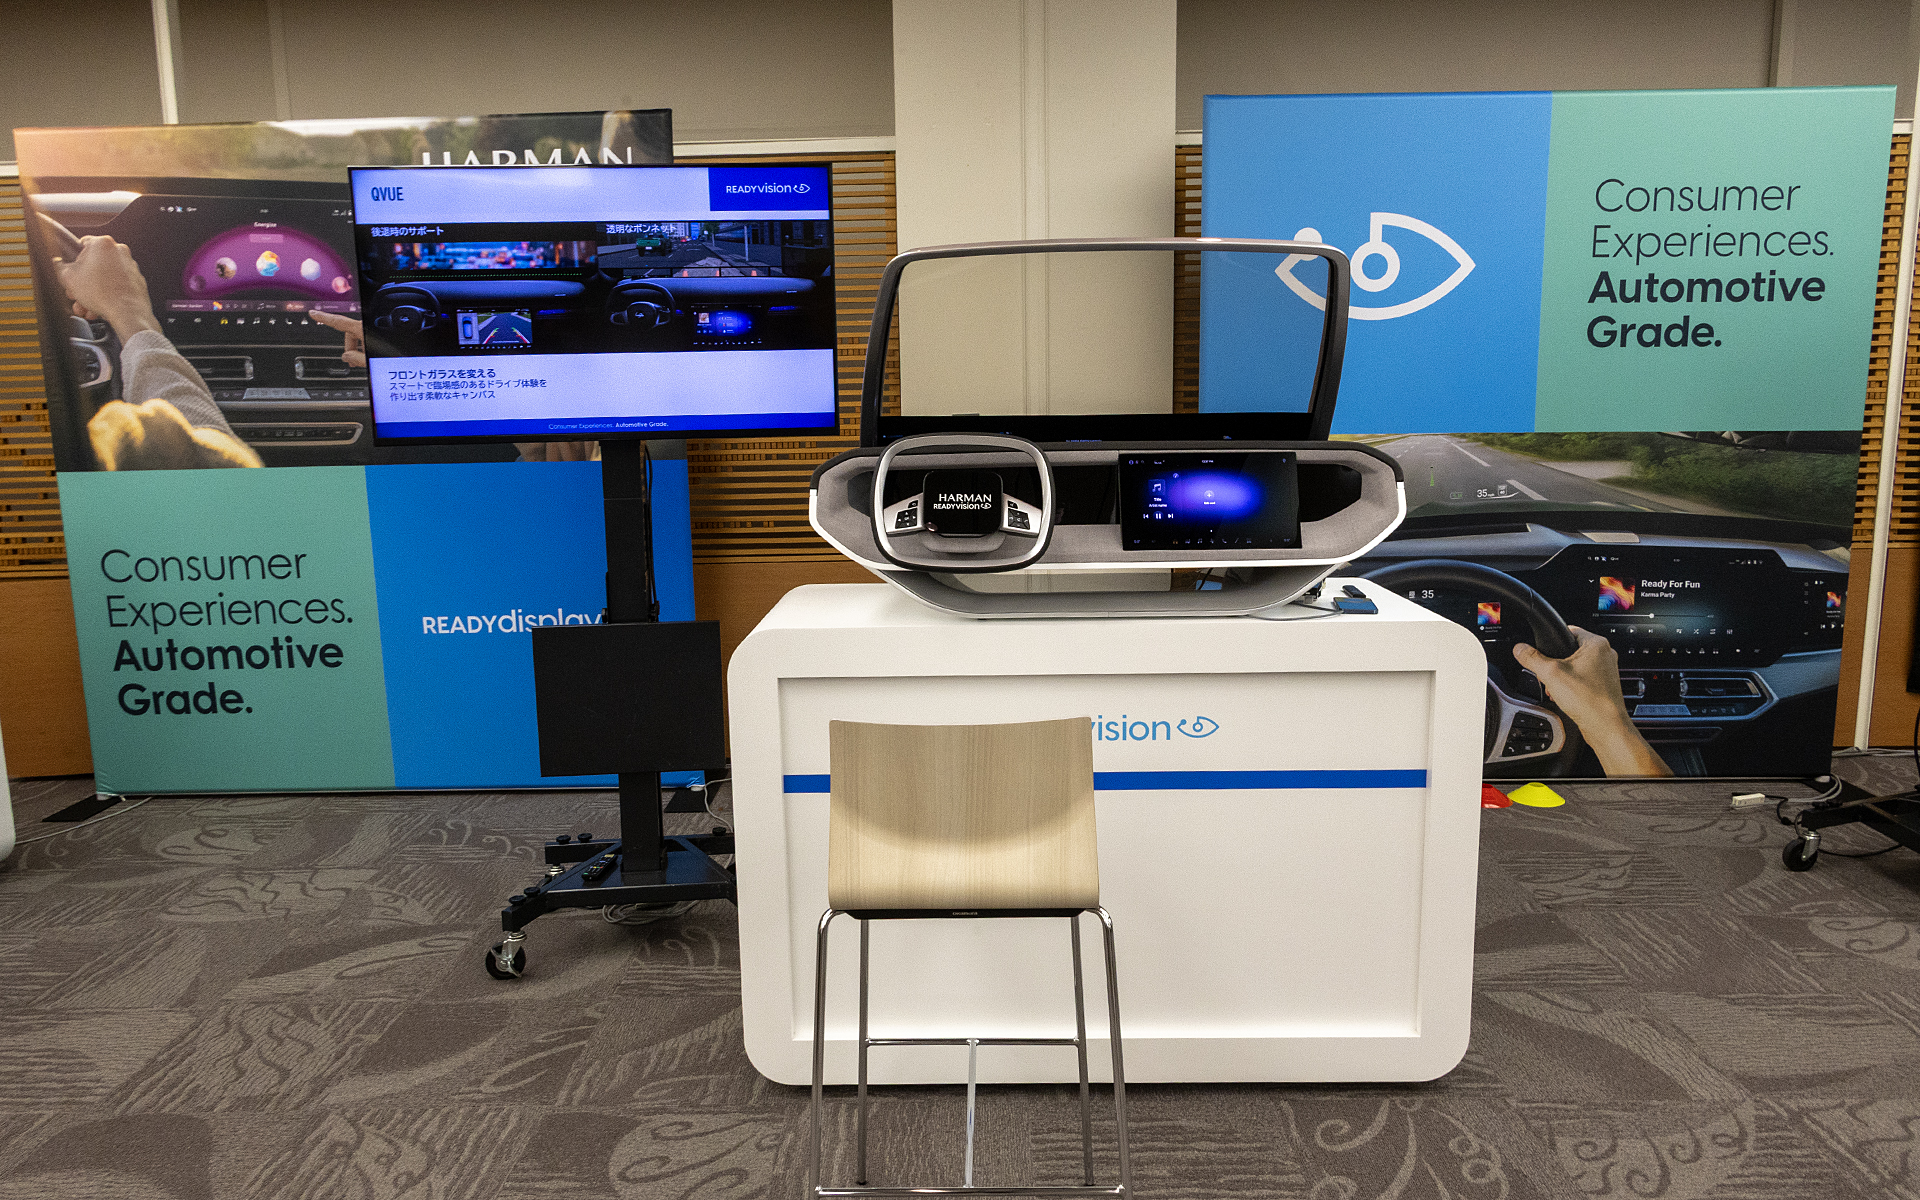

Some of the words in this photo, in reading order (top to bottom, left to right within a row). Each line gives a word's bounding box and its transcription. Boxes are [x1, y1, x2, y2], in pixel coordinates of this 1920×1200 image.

[371, 186, 404, 201] QVUE
[726, 183, 792, 194] READYvision
[1595, 178, 1801, 212] Consumer
[1592, 223, 1834, 265] Experiences.
[1587, 269, 1826, 303] Automotive
[1587, 315, 1722, 348] Grade.
[388, 368, 496, 380] フロントガラスを変える
[933, 501, 980, 510] READYvision
[939, 493, 992, 502] HARMAN
[1477, 489, 1488, 498] 35
[101, 548, 307, 583] Consumer
[1421, 589, 1434, 599] 35
[1641, 580, 1667, 589] Ready
[1669, 580, 1683, 588] For
[106, 592, 354, 635] Experiences.
[113, 635, 344, 672] Automotive
[118, 682, 253, 717] Grade.
[1091, 715, 1171, 741] ision
